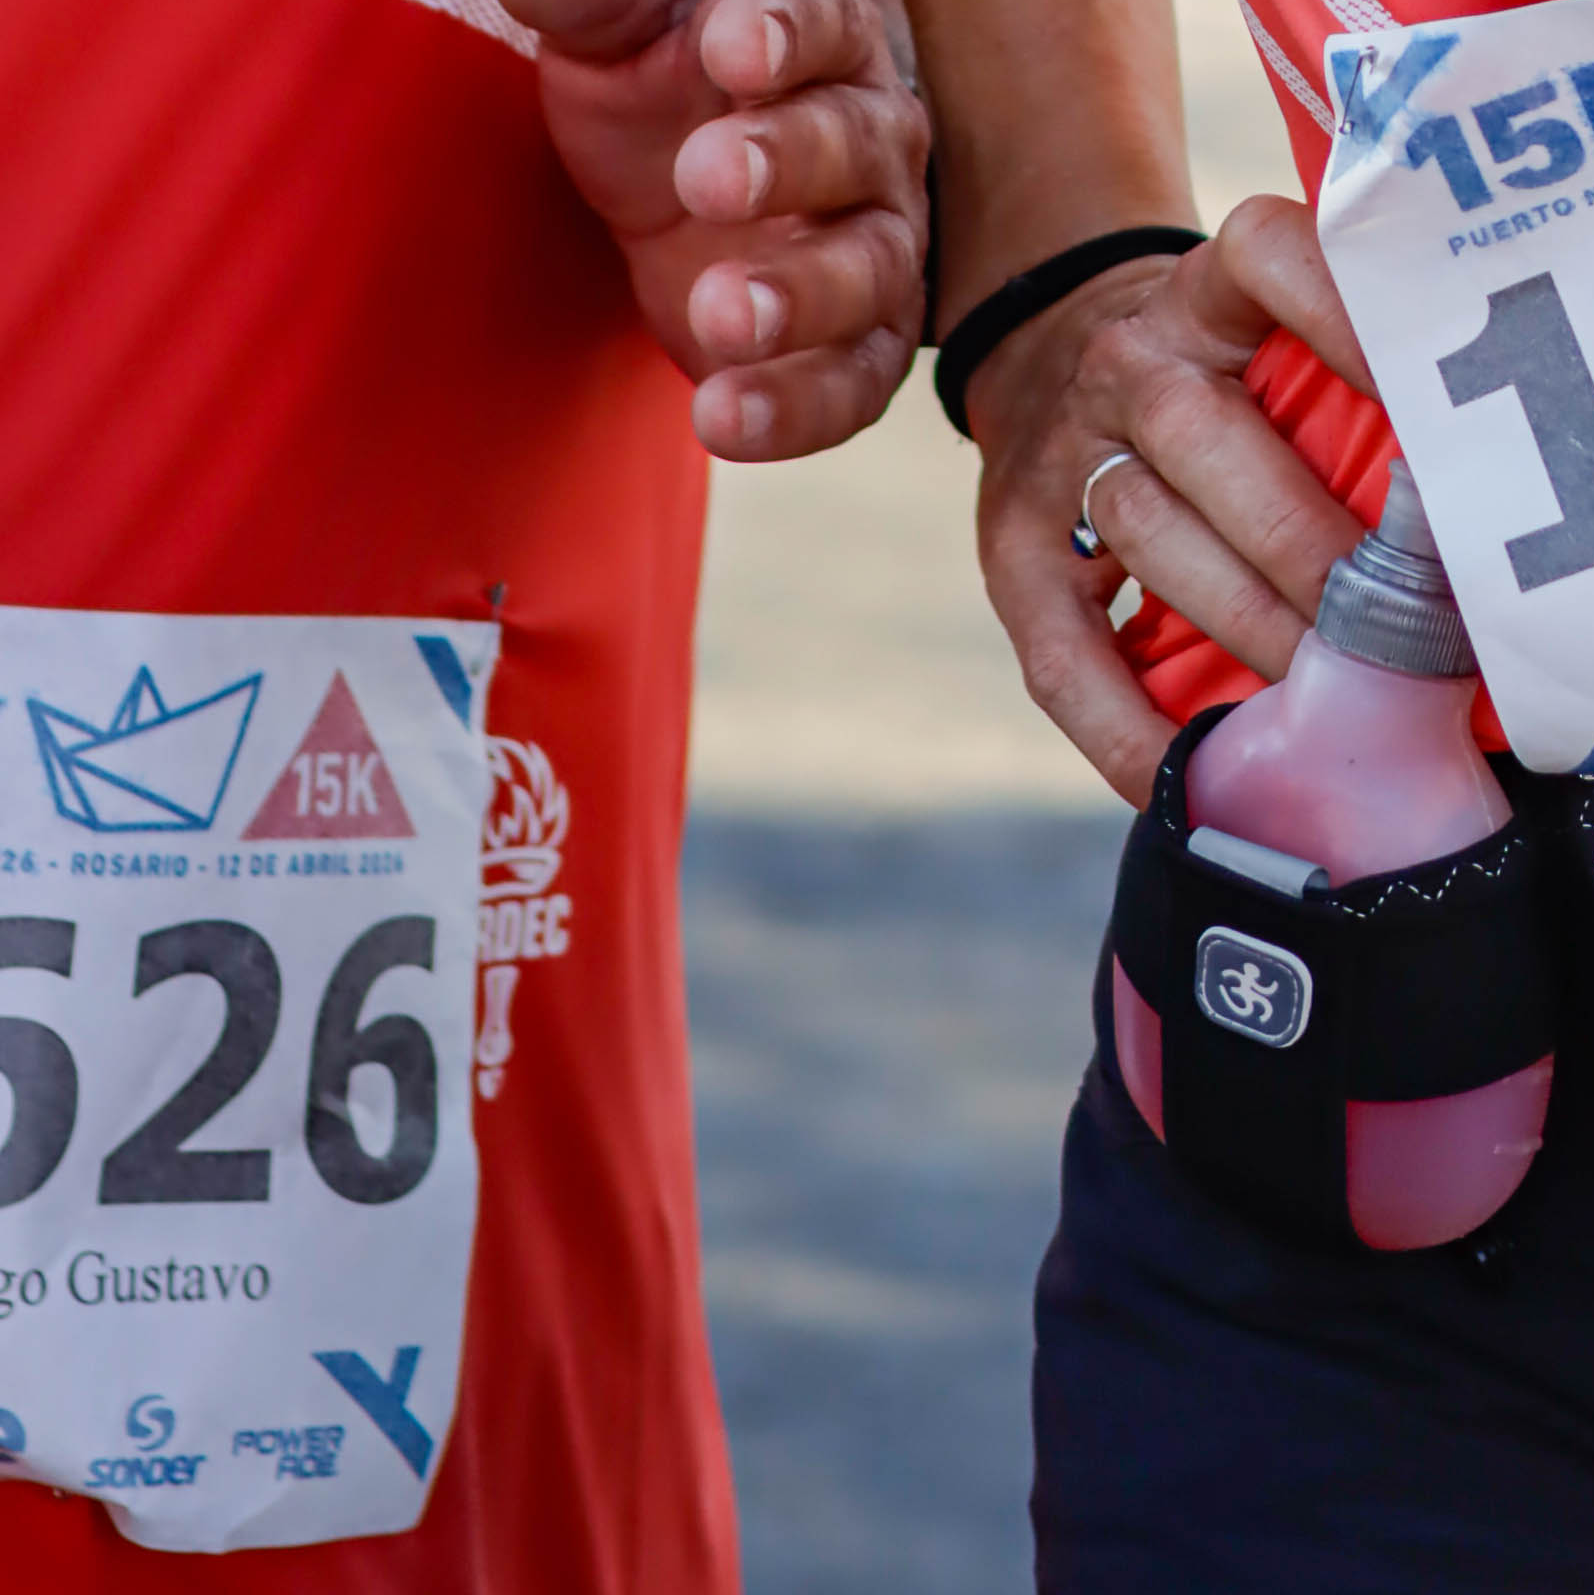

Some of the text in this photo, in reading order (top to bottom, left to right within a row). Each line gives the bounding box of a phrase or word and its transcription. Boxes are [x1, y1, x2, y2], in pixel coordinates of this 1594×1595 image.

[1448, 197, 1575, 257] PUERTO
[293, 753, 380, 817] 15K
[71, 851, 190, 878] ROSARIO
[217, 854, 240, 877] 12
[250, 854, 277, 877] DE
[286, 853, 352, 876] ABRIL
[67, 1249, 271, 1307] Gustavo
